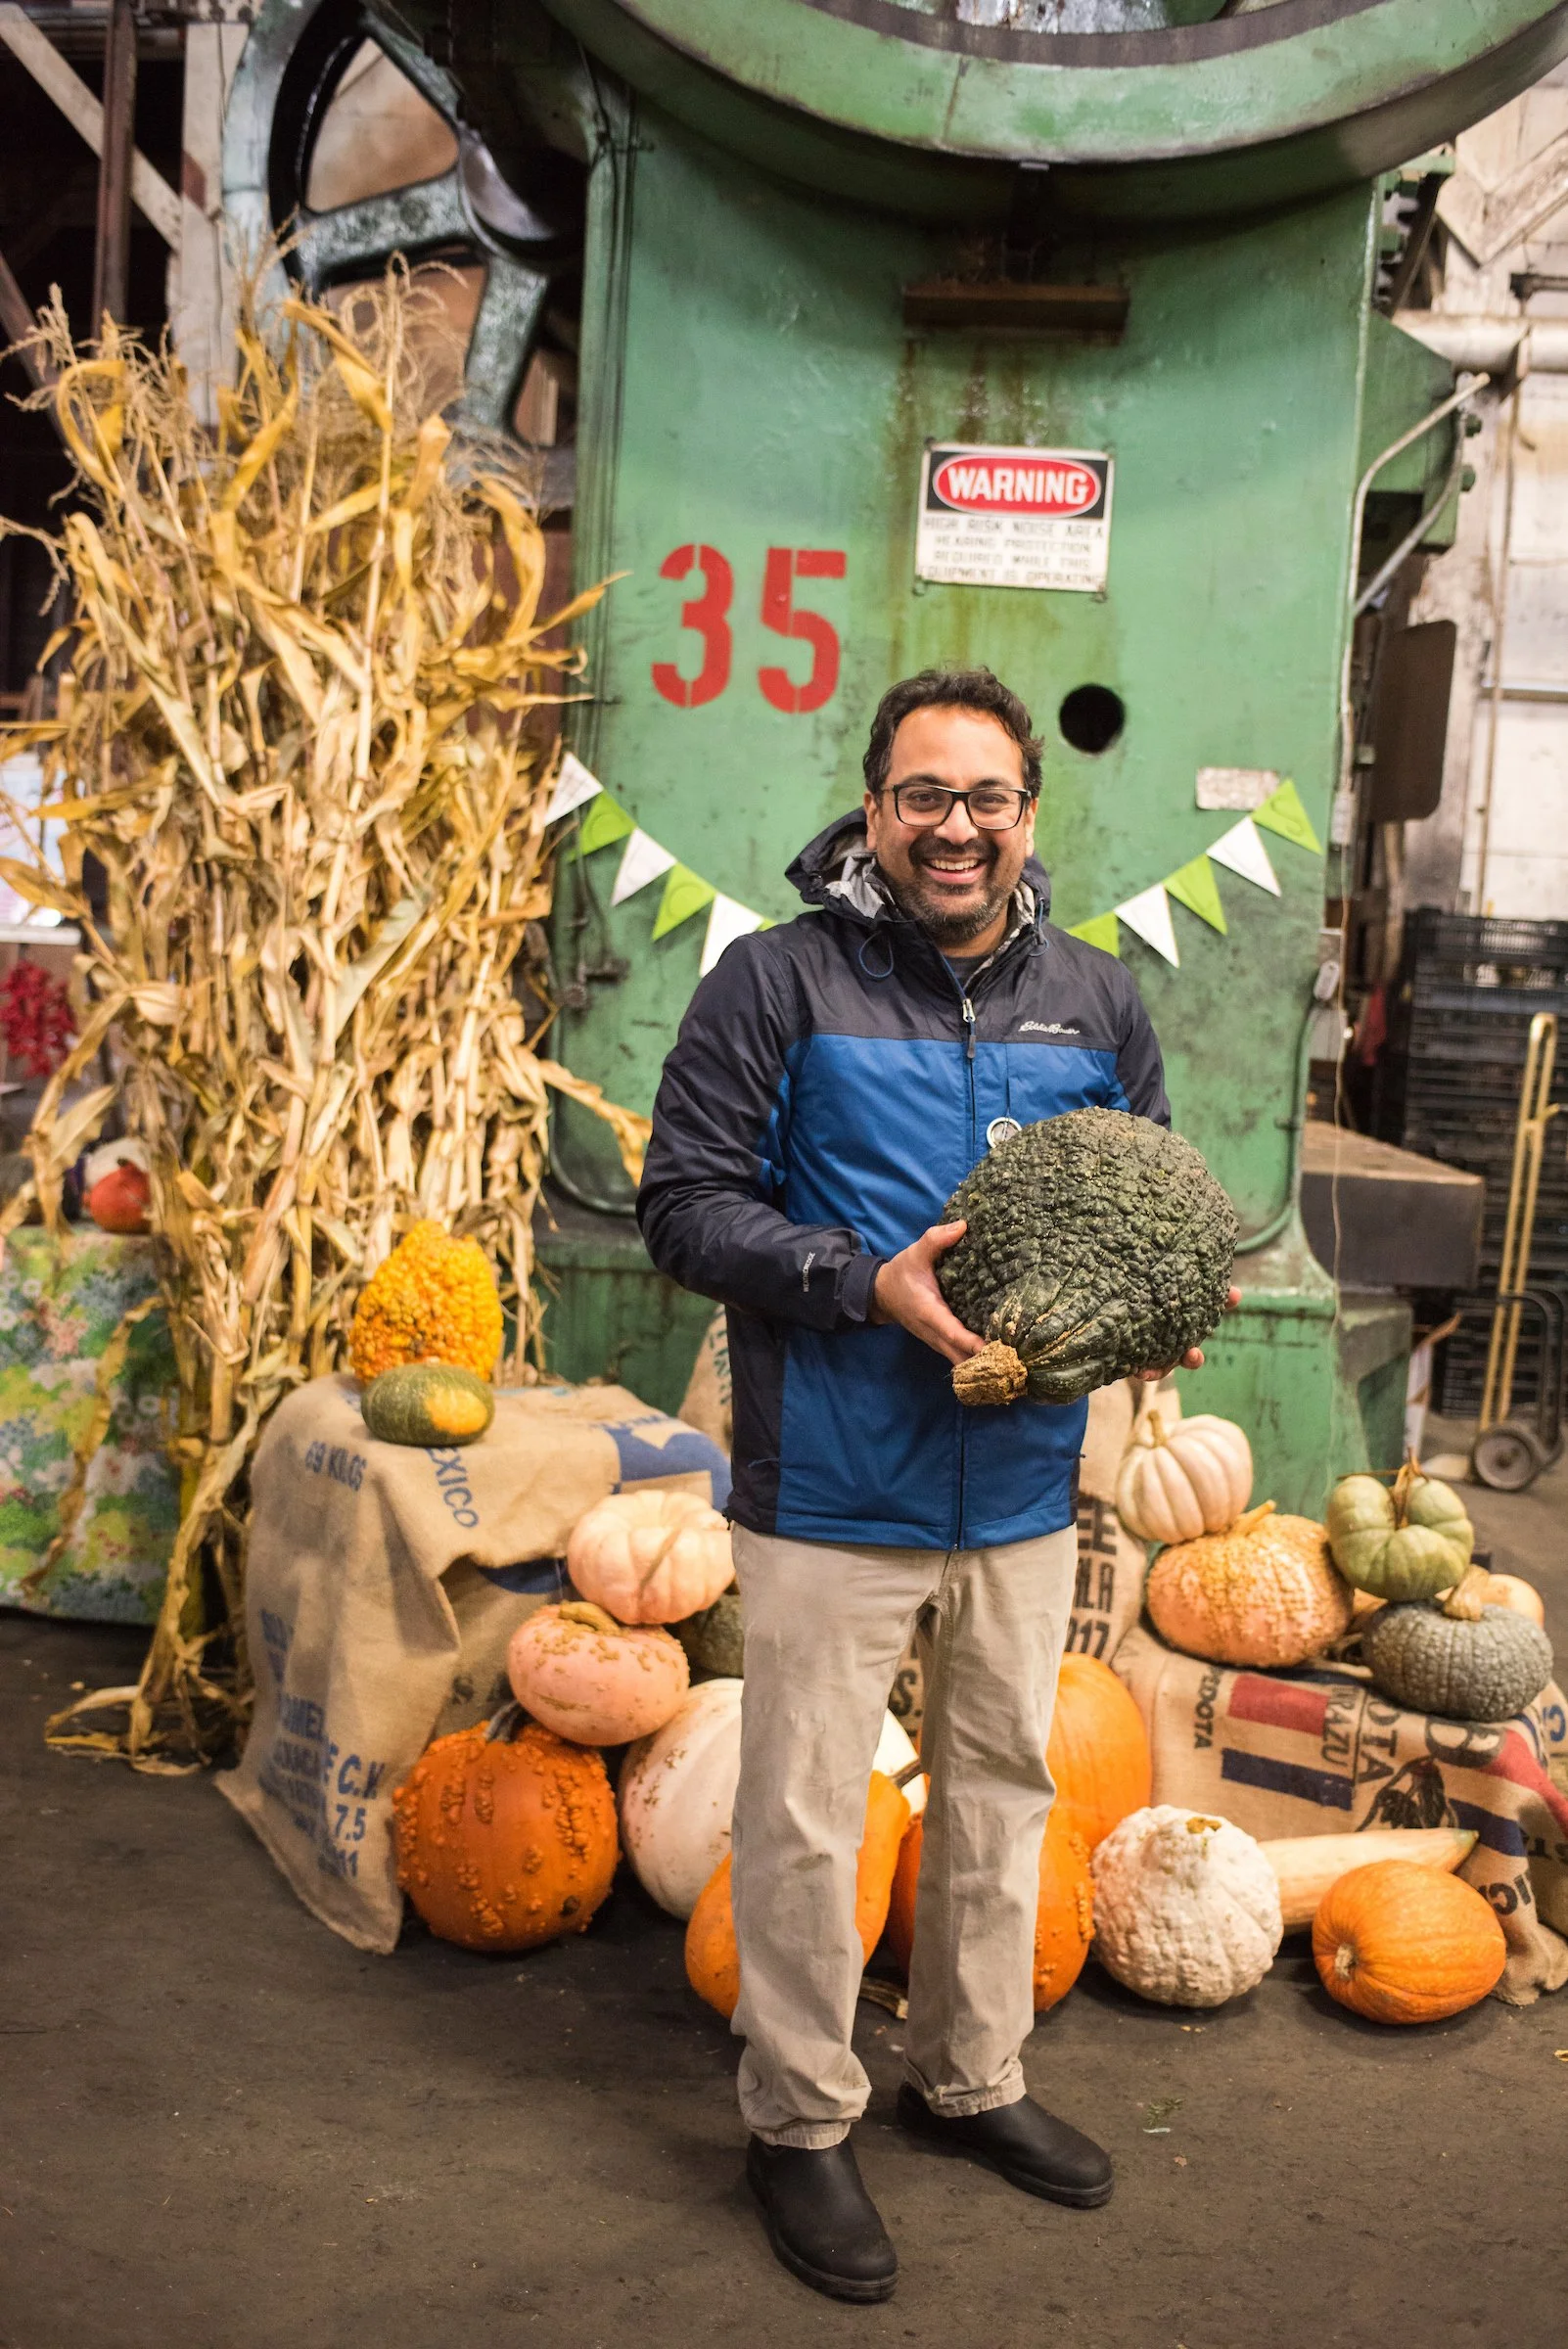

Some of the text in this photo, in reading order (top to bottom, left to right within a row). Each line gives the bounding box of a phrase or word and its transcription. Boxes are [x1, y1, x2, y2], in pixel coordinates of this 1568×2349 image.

[946, 466, 1089, 505] WARNING
[968, 519, 1002, 532] RISK
[1013, 522, 1055, 536] NOISE
[1065, 526, 1103, 539] AREA
[936, 536, 1090, 553] HEARING PROTECTION
[934, 550, 1089, 569] REQUIRED WHILE THIS
[921, 565, 1105, 585] EQUIPMENT IS OPERATING
[651, 544, 848, 714] 35
[425, 1447, 479, 1528] EXICO
[1358, 1699, 1402, 1784] OTA
